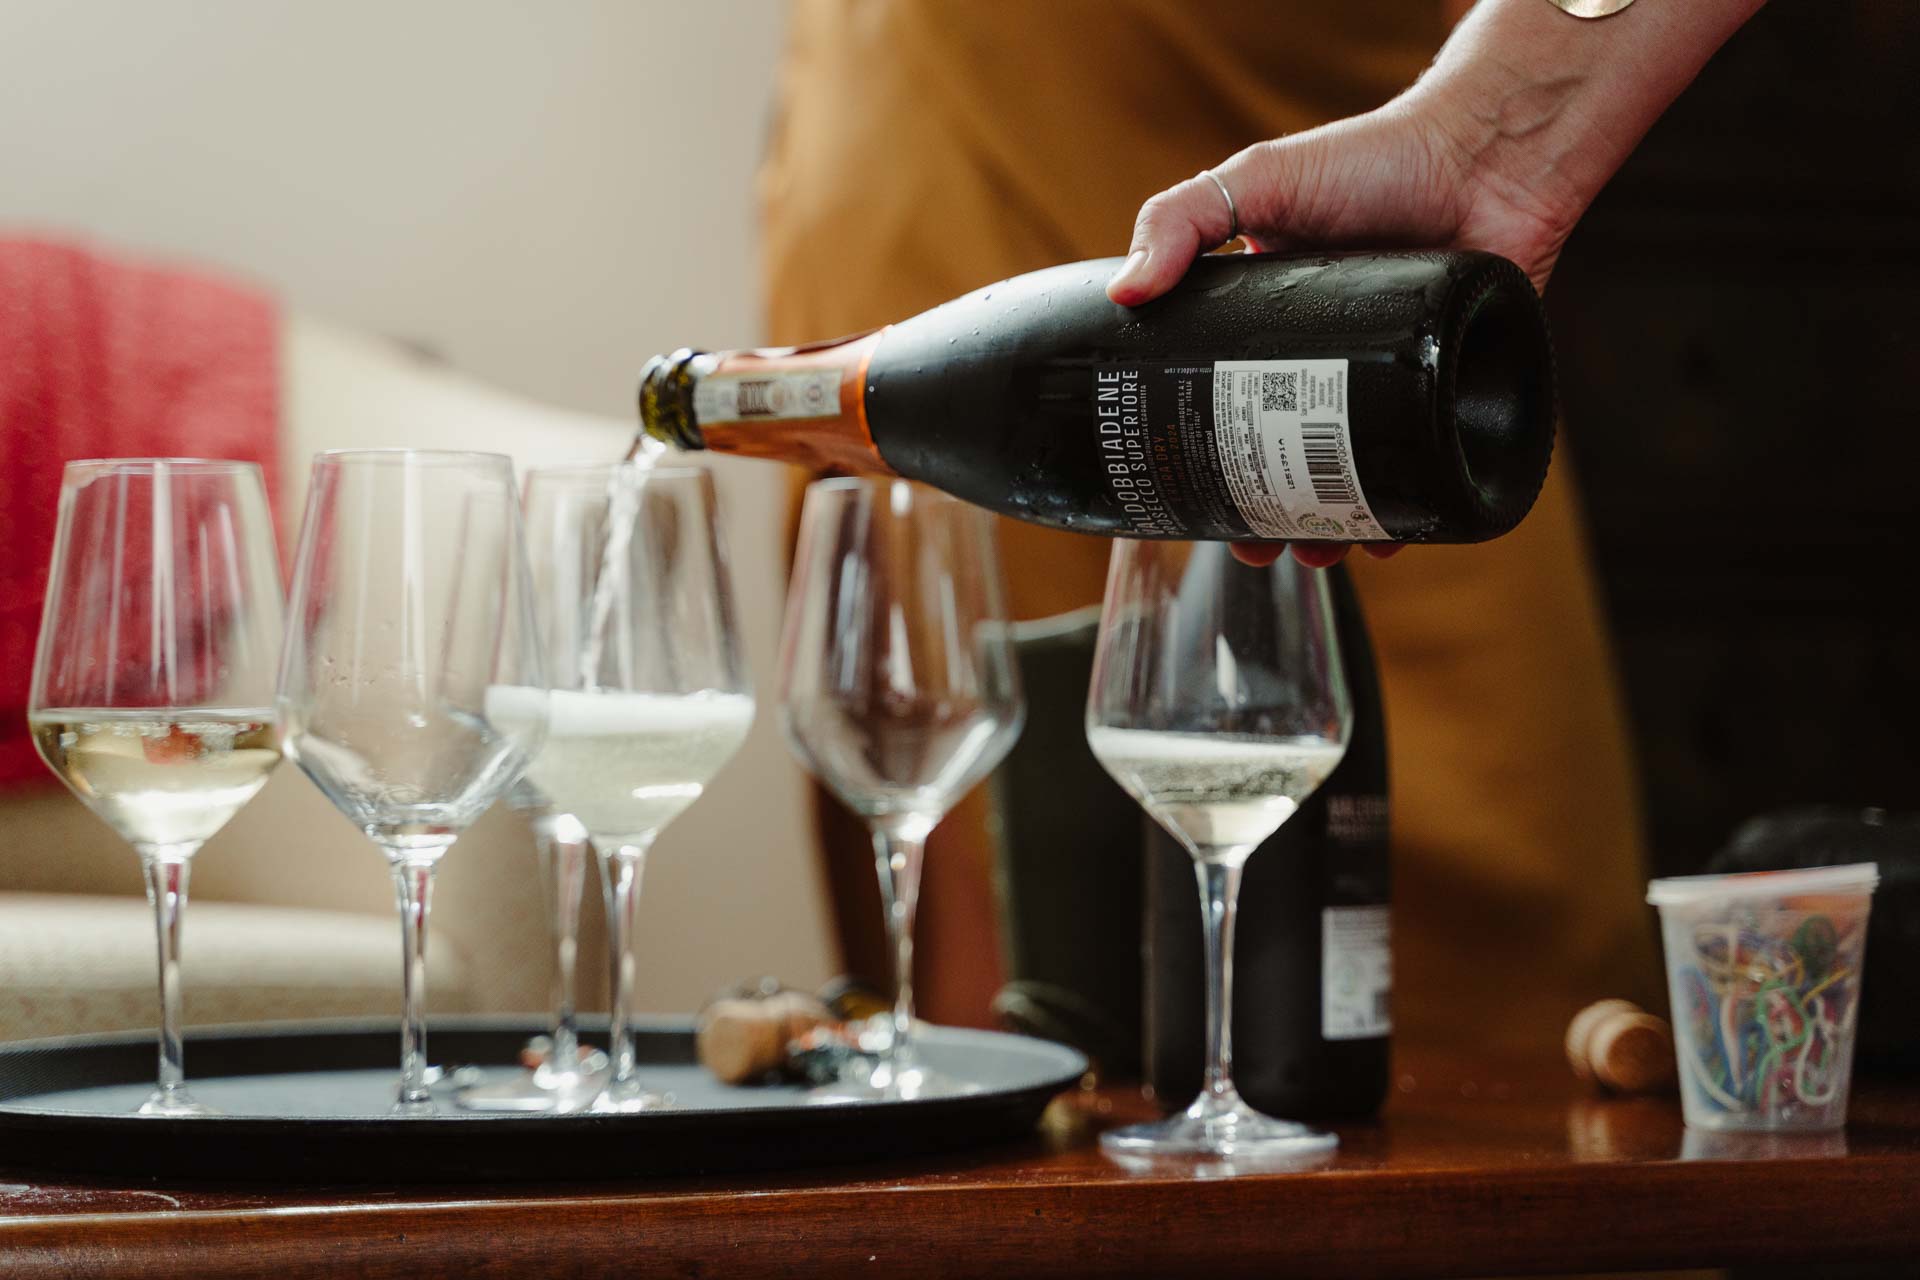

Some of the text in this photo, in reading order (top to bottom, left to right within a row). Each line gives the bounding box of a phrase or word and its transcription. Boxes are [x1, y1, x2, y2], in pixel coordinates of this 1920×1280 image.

[1098, 371, 1164, 534] VALDOBBIADENE
[1122, 370, 1147, 470] SUPERIORE
[1156, 436, 1168, 461] DRY
[1135, 479, 1184, 535] PROSECCO
